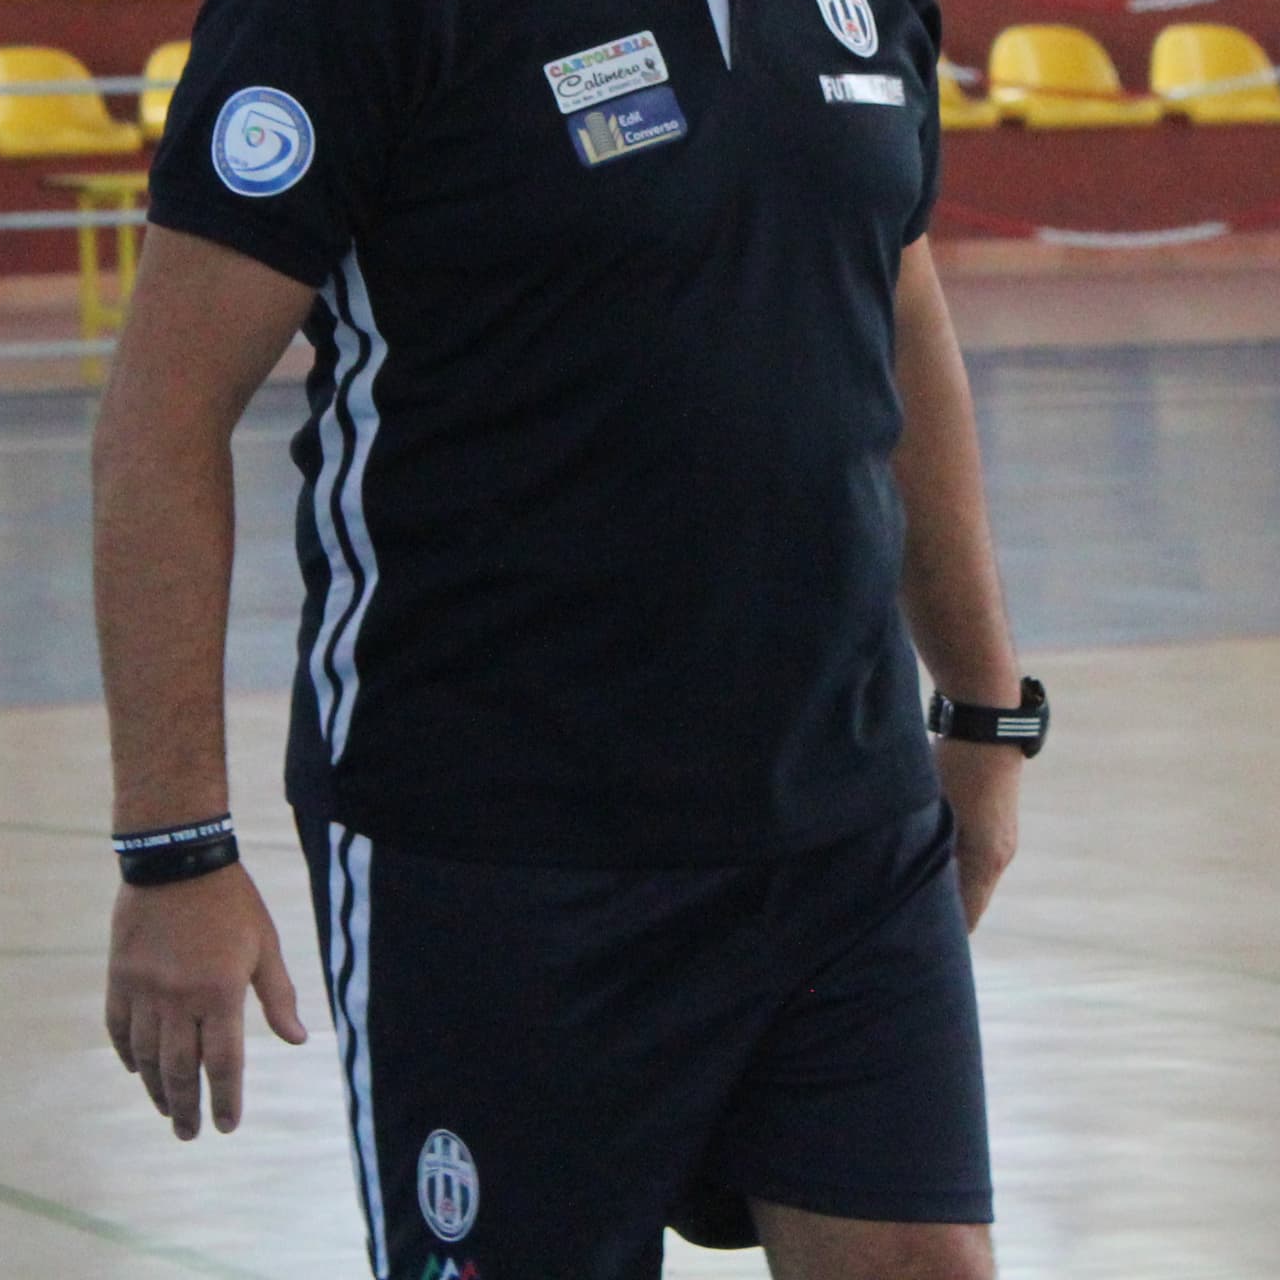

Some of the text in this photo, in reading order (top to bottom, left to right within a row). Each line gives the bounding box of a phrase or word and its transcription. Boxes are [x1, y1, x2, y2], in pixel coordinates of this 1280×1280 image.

[548, 36, 654, 78] CARTOLERIA
[556, 64, 641, 98] Calimero
[618, 111, 643, 128] Edil
[625, 120, 680, 144] Converso
